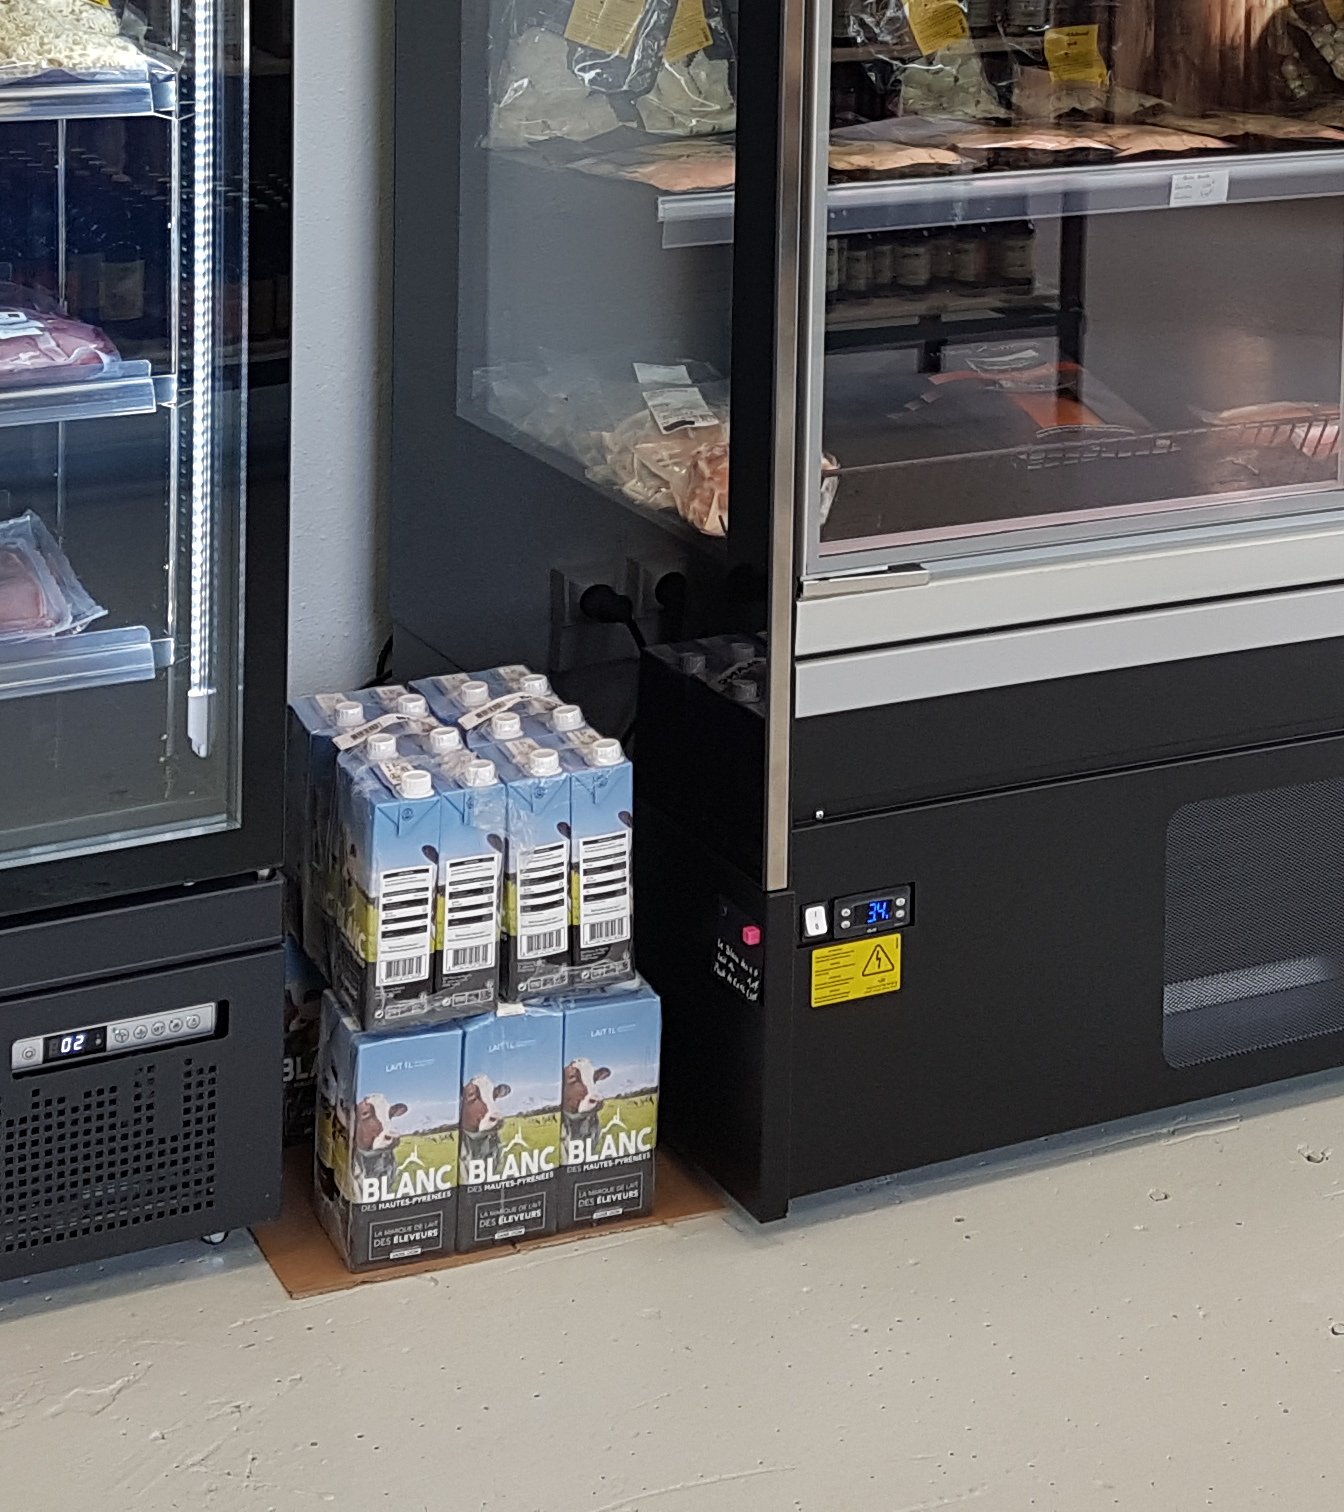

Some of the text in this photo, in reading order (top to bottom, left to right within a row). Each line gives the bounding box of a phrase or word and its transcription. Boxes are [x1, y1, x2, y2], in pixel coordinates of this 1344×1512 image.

[590, 1028, 607, 1038] LAIT
[60, 1034, 85, 1054] 02
[488, 1042, 505, 1053] LAIT
[385, 1062, 403, 1073] LAIT
[568, 1127, 653, 1165] BLANC
[468, 1146, 555, 1185] BLANC
[567, 1165, 582, 1174] DES
[362, 1164, 452, 1204] BLANC
[467, 1185, 483, 1193] DES
[578, 1197, 595, 1208] DES
[361, 1204, 377, 1213] DES
[479, 1216, 496, 1228] DES
[373, 1237, 392, 1248] DES
